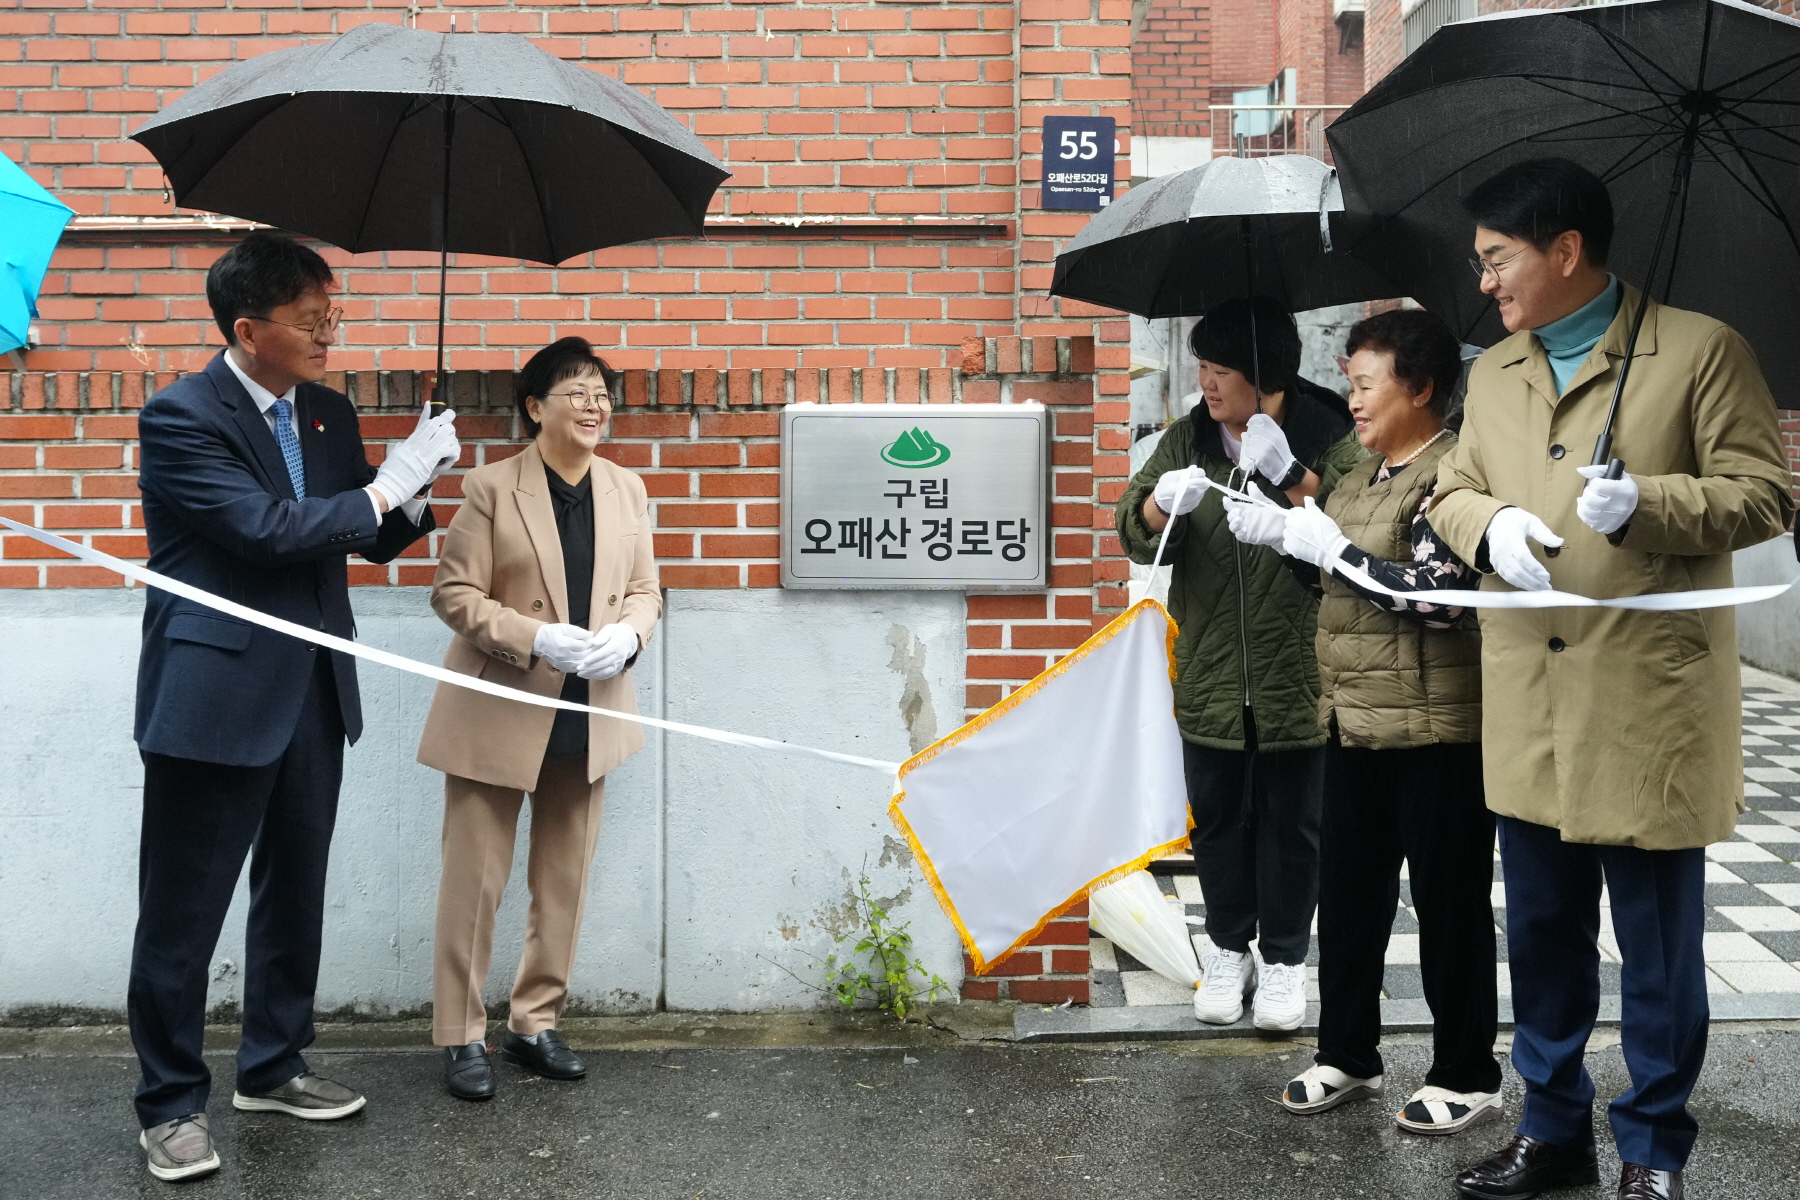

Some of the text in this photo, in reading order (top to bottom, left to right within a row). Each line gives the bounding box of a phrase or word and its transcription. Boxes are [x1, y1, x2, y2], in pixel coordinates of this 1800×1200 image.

[1060, 131, 1098, 160] 55
[1047, 173, 1108, 184] 오패산로52다길
[883, 478, 949, 509] 구립
[800, 517, 1031, 562] 오패산 경로당
